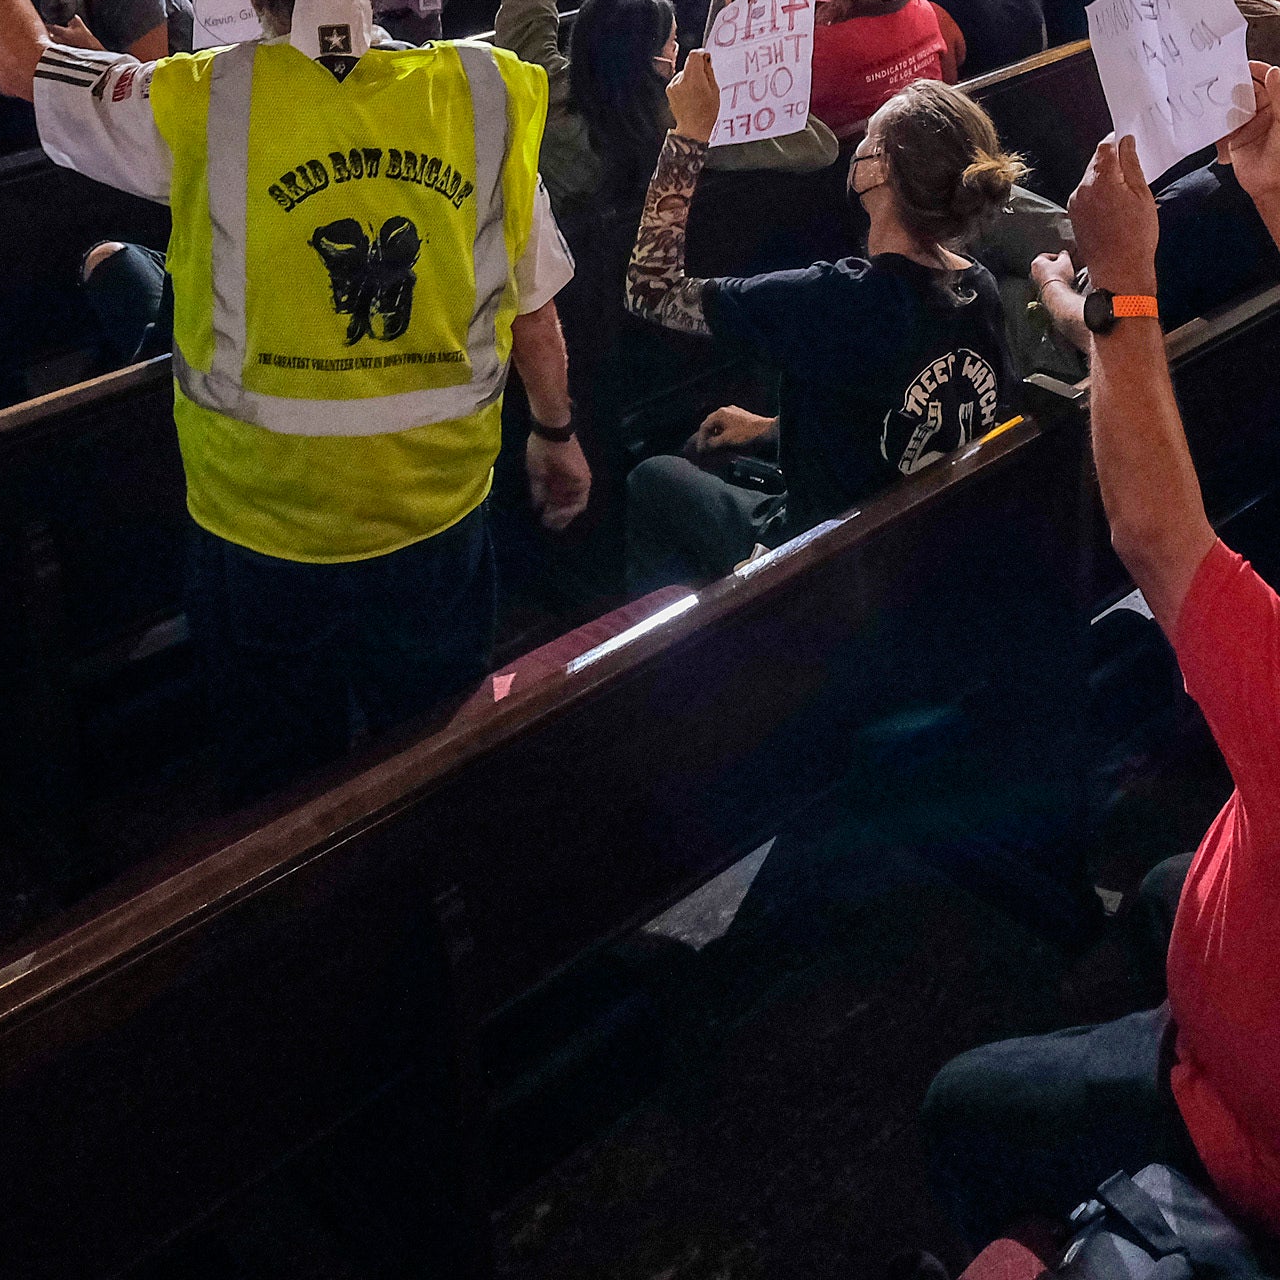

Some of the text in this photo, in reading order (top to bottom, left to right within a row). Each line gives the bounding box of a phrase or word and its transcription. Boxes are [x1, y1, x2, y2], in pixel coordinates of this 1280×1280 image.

[865, 60, 908, 83] SINDICATO
[328, 147, 383, 184] ROW
[385, 148, 474, 210] BRIGADE
[258, 352, 273, 365] THE
[273, 355, 310, 370] GREATEST
[311, 357, 354, 372] VOLUNTEER
[354, 357, 373, 370] UNIT
[373, 356, 383, 369] IN
[384, 353, 424, 368] DOWNTOWN
[424, 352, 436, 364] LOS
[962, 356, 998, 427] WATCH
